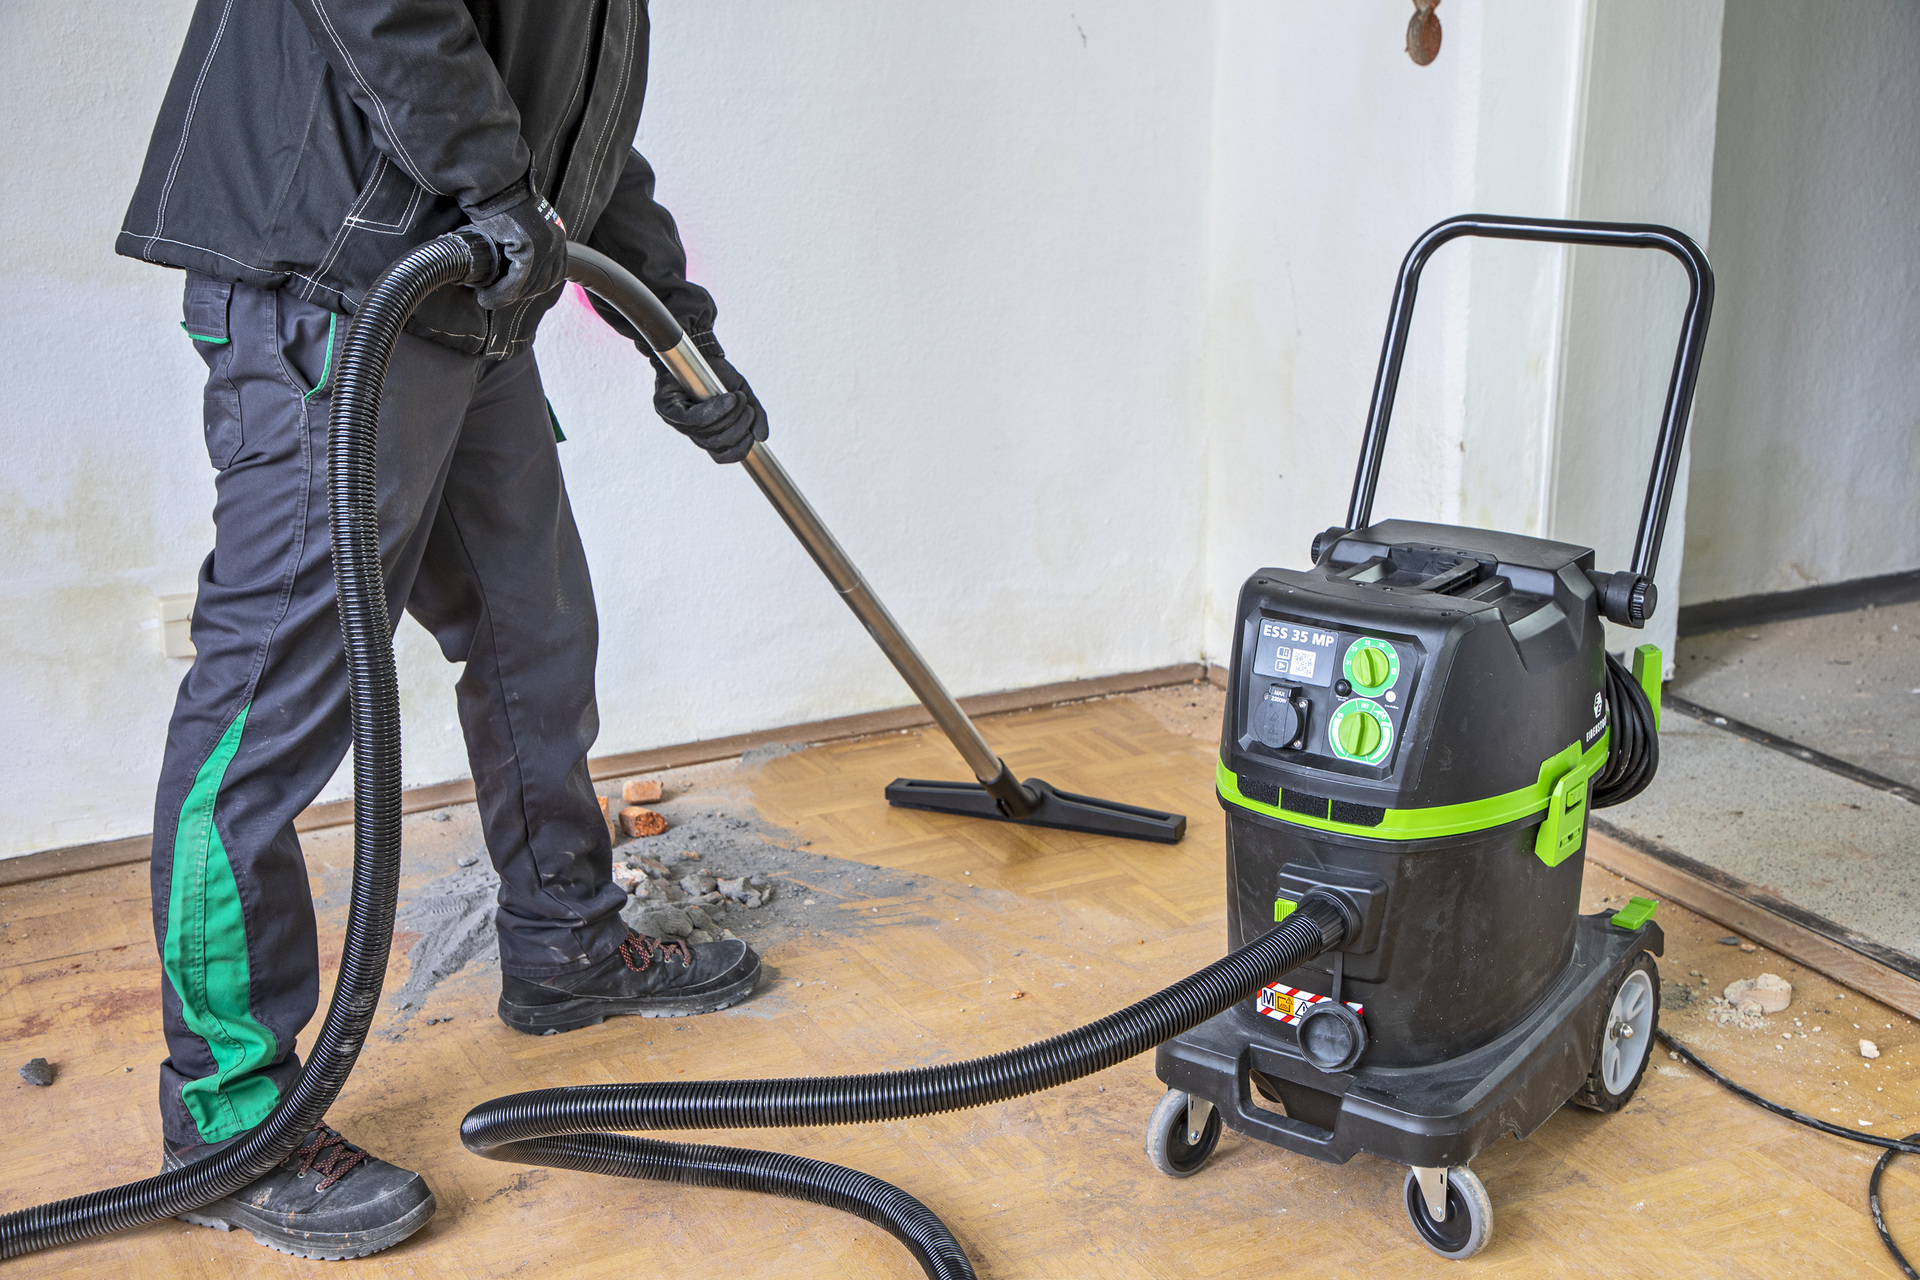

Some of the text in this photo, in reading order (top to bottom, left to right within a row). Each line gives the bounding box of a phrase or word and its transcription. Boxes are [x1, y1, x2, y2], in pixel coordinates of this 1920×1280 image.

[1263, 624, 1335, 648] ESS 35 MP
[1273, 689, 1286, 697] MAX
[1263, 989, 1275, 1007] M
